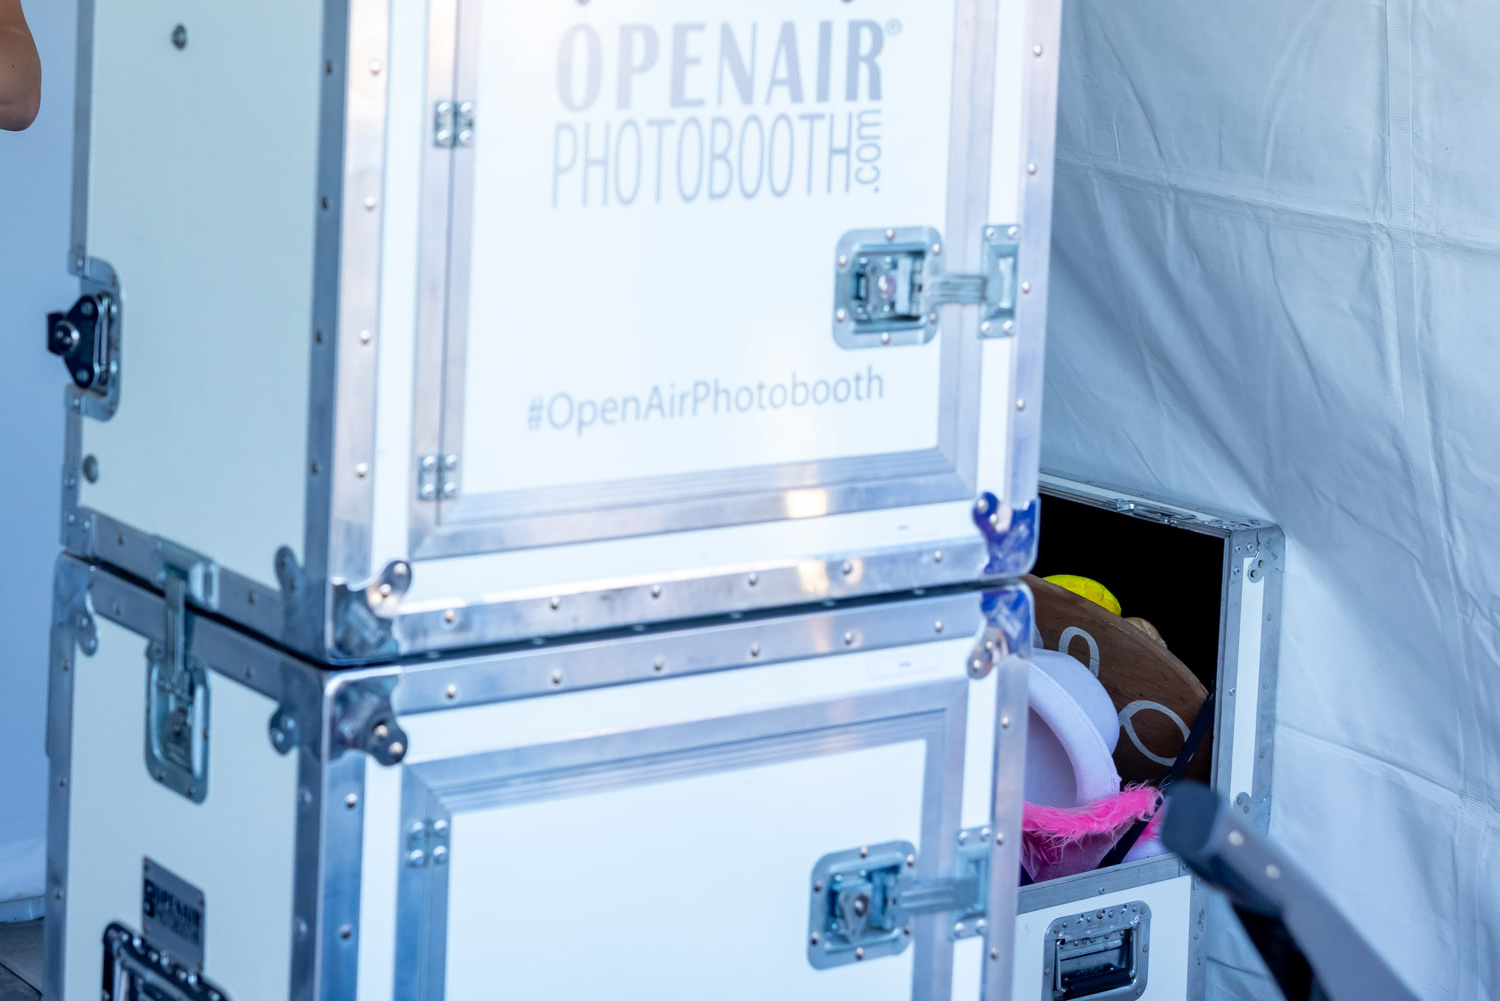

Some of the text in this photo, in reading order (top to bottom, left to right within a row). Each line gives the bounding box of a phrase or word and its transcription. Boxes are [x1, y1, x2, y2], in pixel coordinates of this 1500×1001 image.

[552, 112, 854, 208] PHOTOBOOTH
[854, 108, 883, 193] .com
[527, 364, 885, 436] #OpenAirPhotobooth
